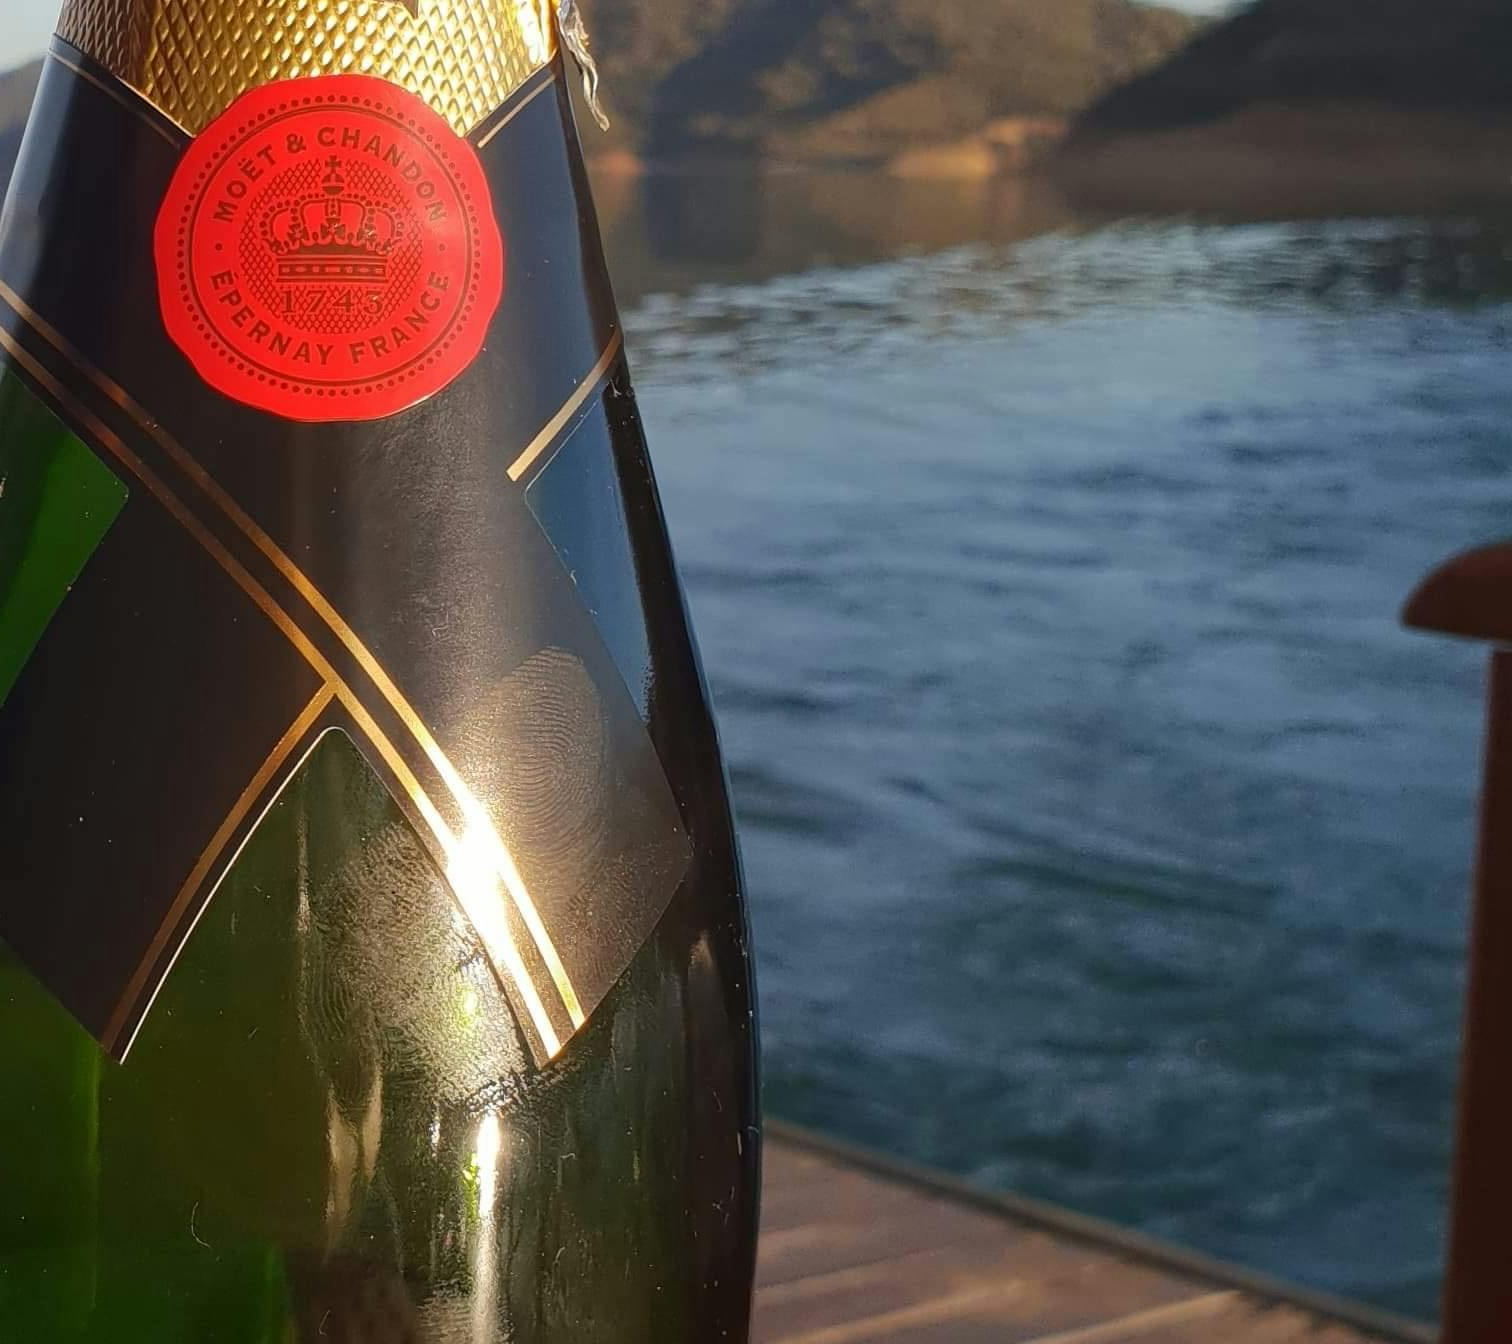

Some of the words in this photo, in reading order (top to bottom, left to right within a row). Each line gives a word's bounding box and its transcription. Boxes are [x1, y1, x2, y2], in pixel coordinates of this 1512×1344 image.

[213, 145, 276, 223] MOËT
[286, 134, 307, 153] &
[317, 127, 447, 222] CHANDON
[210, 270, 333, 365] ÉPERNAY
[349, 272, 449, 364] FRANCE
[281, 290, 384, 314] 1743
